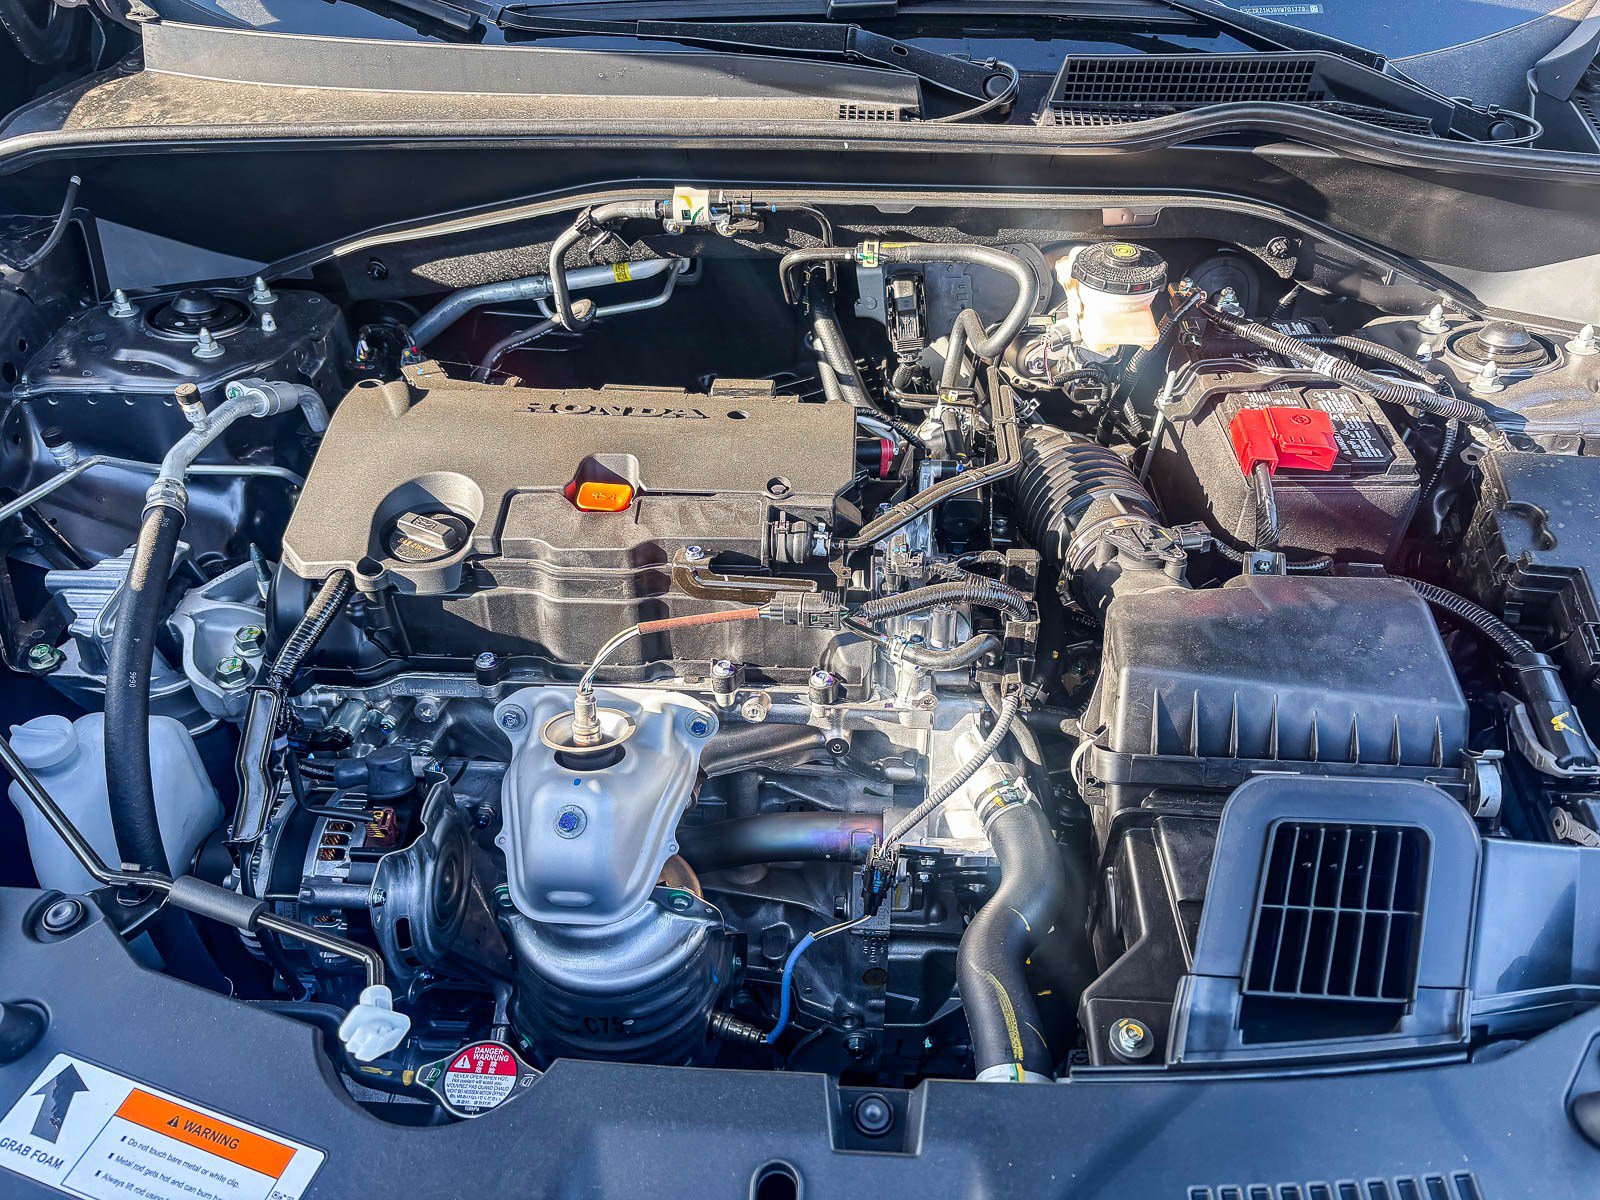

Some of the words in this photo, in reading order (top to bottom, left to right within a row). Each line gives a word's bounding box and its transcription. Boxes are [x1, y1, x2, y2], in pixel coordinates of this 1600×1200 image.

[514, 402, 711, 419] HONDA
[473, 1053, 510, 1062] WARNUNG
[474, 1047, 505, 1055] DANGER
[182, 1119, 240, 1150] WARNING
[0, 1137, 31, 1156] GRAB
[30, 1149, 64, 1169] FOAM
[127, 1138, 138, 1148] Do
[138, 1143, 150, 1152] not
[149, 1147, 167, 1159] touch
[166, 1153, 183, 1165] bare
[182, 1161, 202, 1173] metal
[209, 1172, 227, 1183] white
[101, 1173, 125, 1188] Always
[133, 1187, 147, 1196] rod
[114, 1155, 134, 1168] Metal
[132, 1163, 146, 1172] rod
[142, 1168, 159, 1178] gets
[159, 1173, 172, 1183] hot
[170, 1179, 185, 1189] and
[184, 1185, 197, 1194] can
